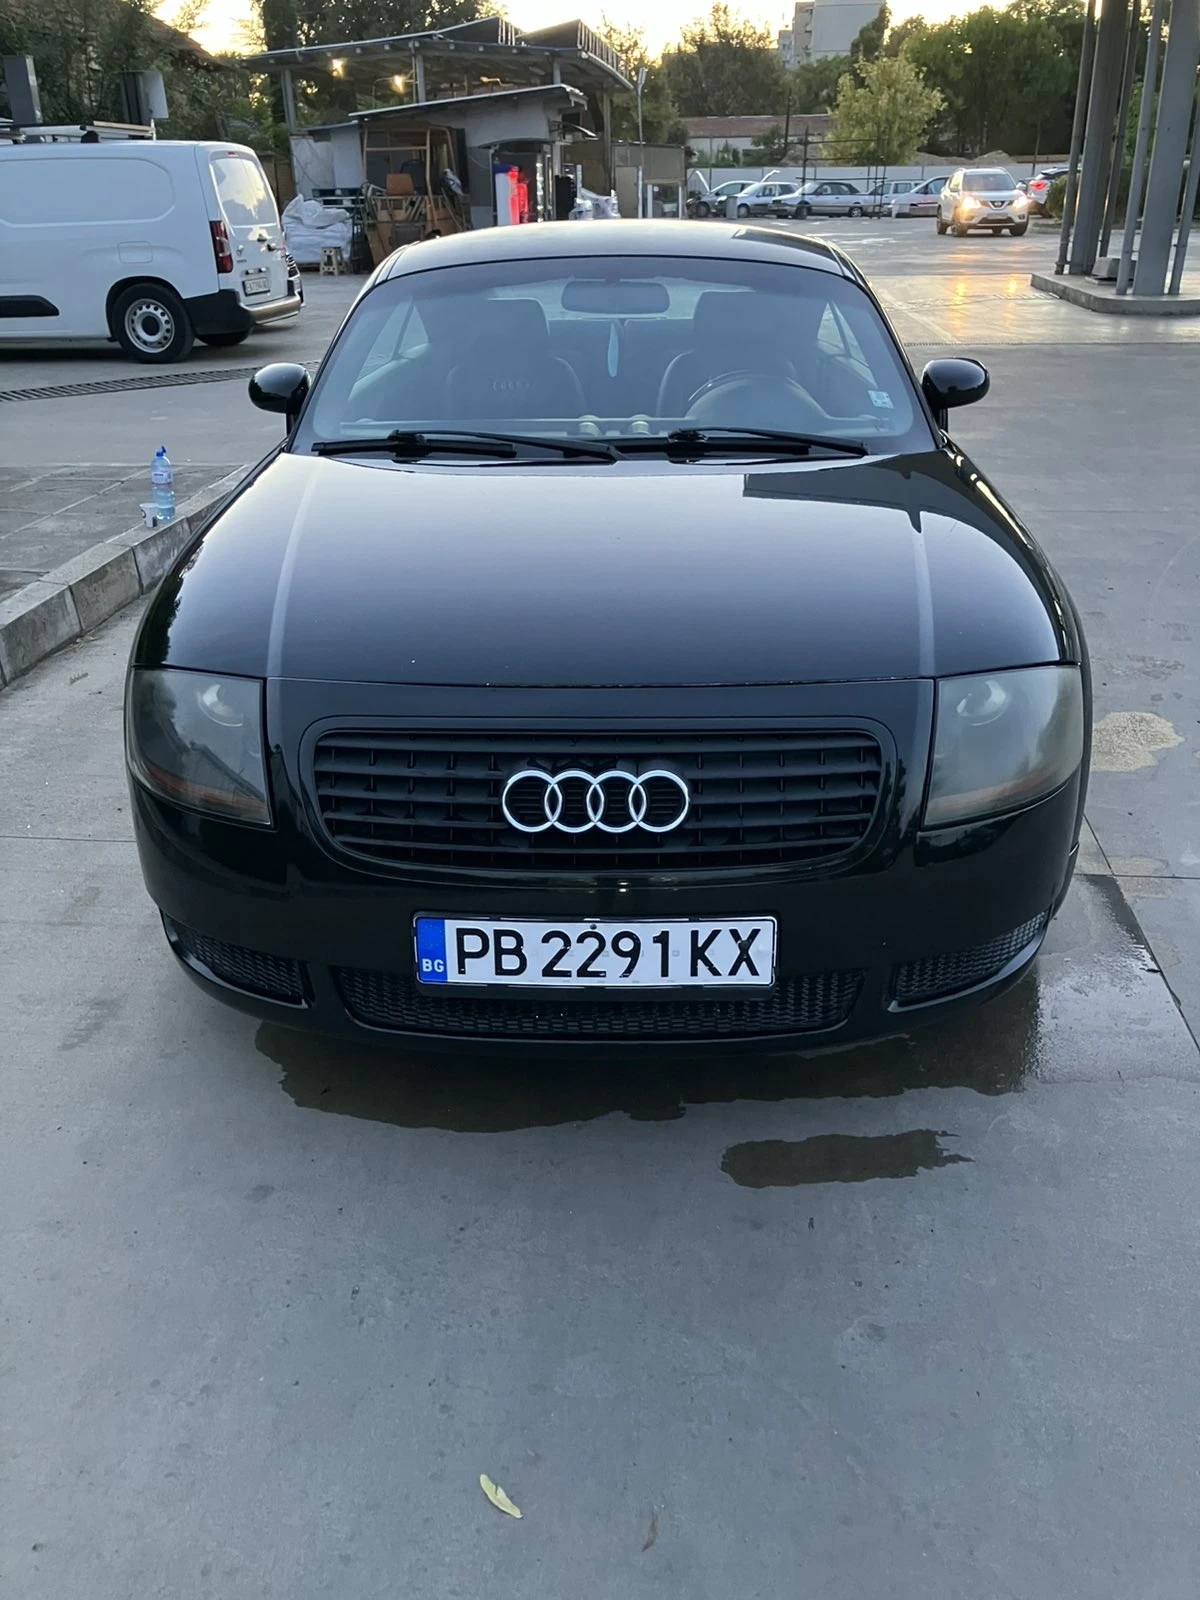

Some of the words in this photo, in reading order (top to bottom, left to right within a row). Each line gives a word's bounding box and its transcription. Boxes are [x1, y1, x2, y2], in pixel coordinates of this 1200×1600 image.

[422, 958, 445, 973] BG
[456, 927, 528, 976] PB
[540, 929, 670, 978] 2291
[690, 928, 761, 977] KX
